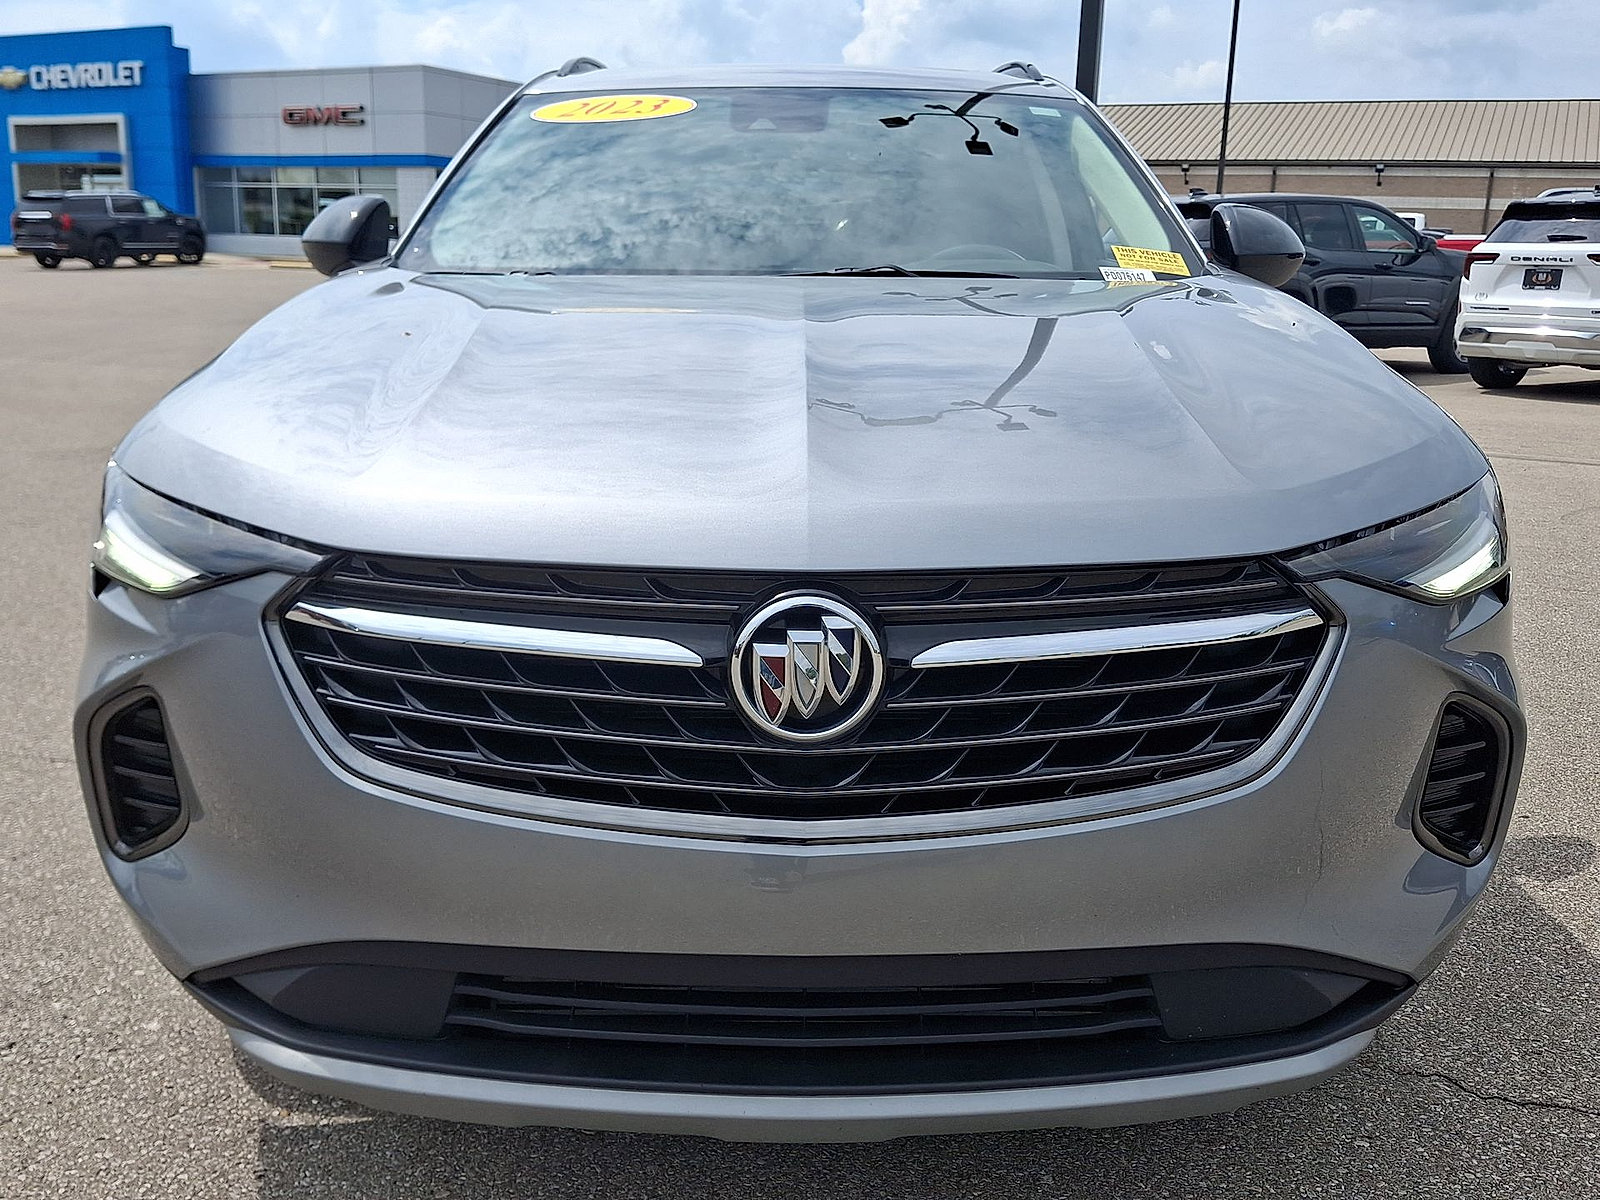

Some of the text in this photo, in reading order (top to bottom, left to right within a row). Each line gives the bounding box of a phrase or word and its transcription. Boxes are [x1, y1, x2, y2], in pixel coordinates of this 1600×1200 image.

[29, 60, 144, 90] CHEVROLET
[280, 103, 366, 126] GMC
[556, 98, 670, 118] 2023
[1114, 246, 1180, 260] THIS VEHICLE
[1510, 255, 1574, 263] DENALI
